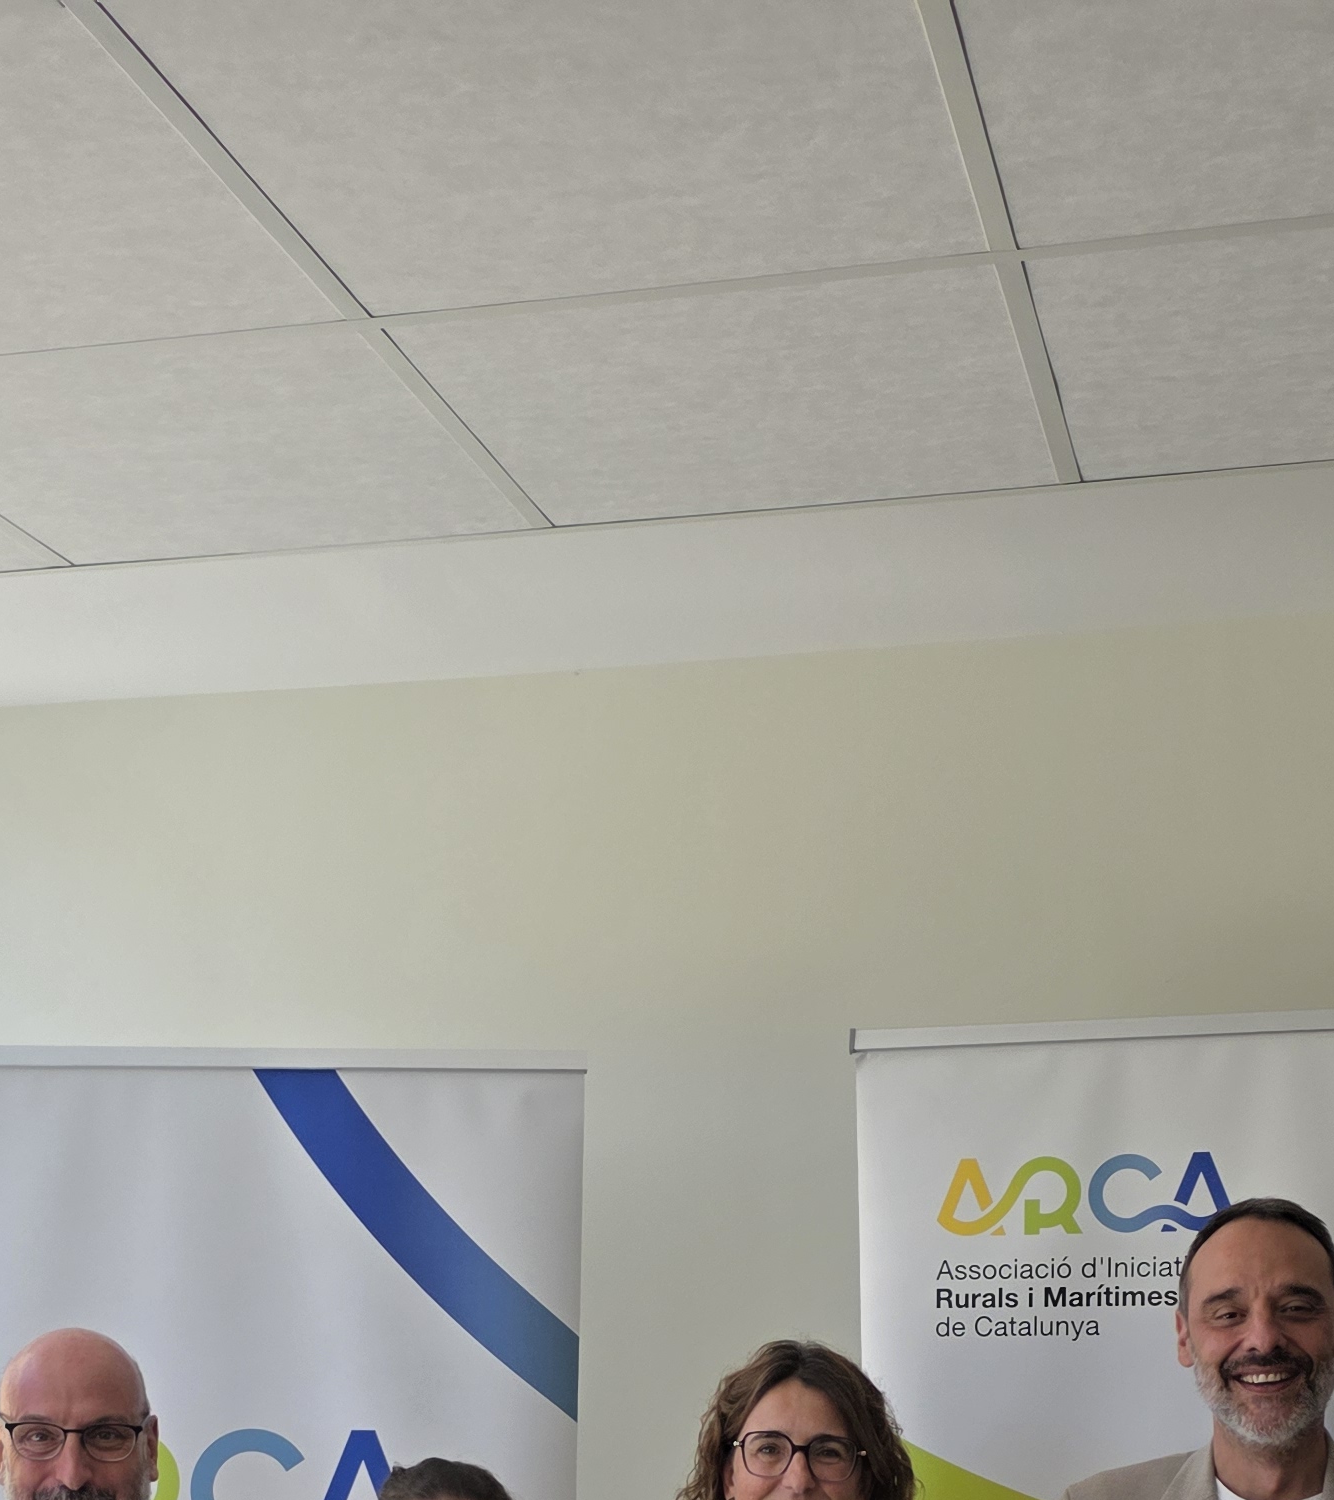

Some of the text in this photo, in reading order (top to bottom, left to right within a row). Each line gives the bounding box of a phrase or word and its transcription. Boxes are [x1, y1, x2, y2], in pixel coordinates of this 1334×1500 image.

[936, 1256, 1189, 1280] Associació d'Iniciat
[936, 1284, 1179, 1309] Rurals i Marítimes
[935, 1316, 1101, 1341] de Catalunya
